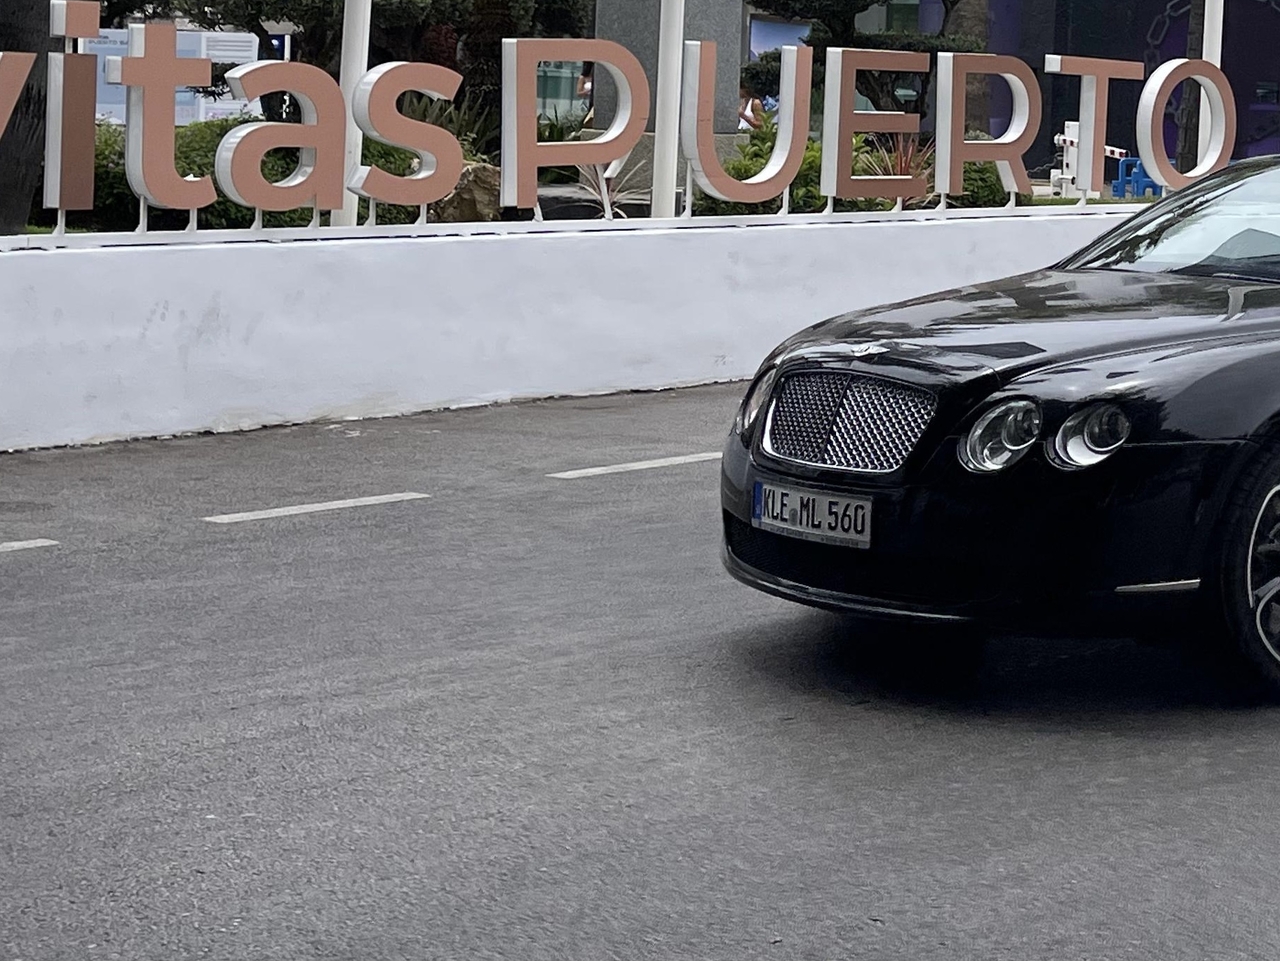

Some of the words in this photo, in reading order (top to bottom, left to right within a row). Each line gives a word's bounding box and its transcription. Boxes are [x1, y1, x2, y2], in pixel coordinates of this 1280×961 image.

[0, 0, 464, 211] itas
[503, 38, 1237, 208] PUERTO
[763, 488, 790, 523] KLE
[799, 495, 822, 529] ML
[827, 500, 866, 535] 560
